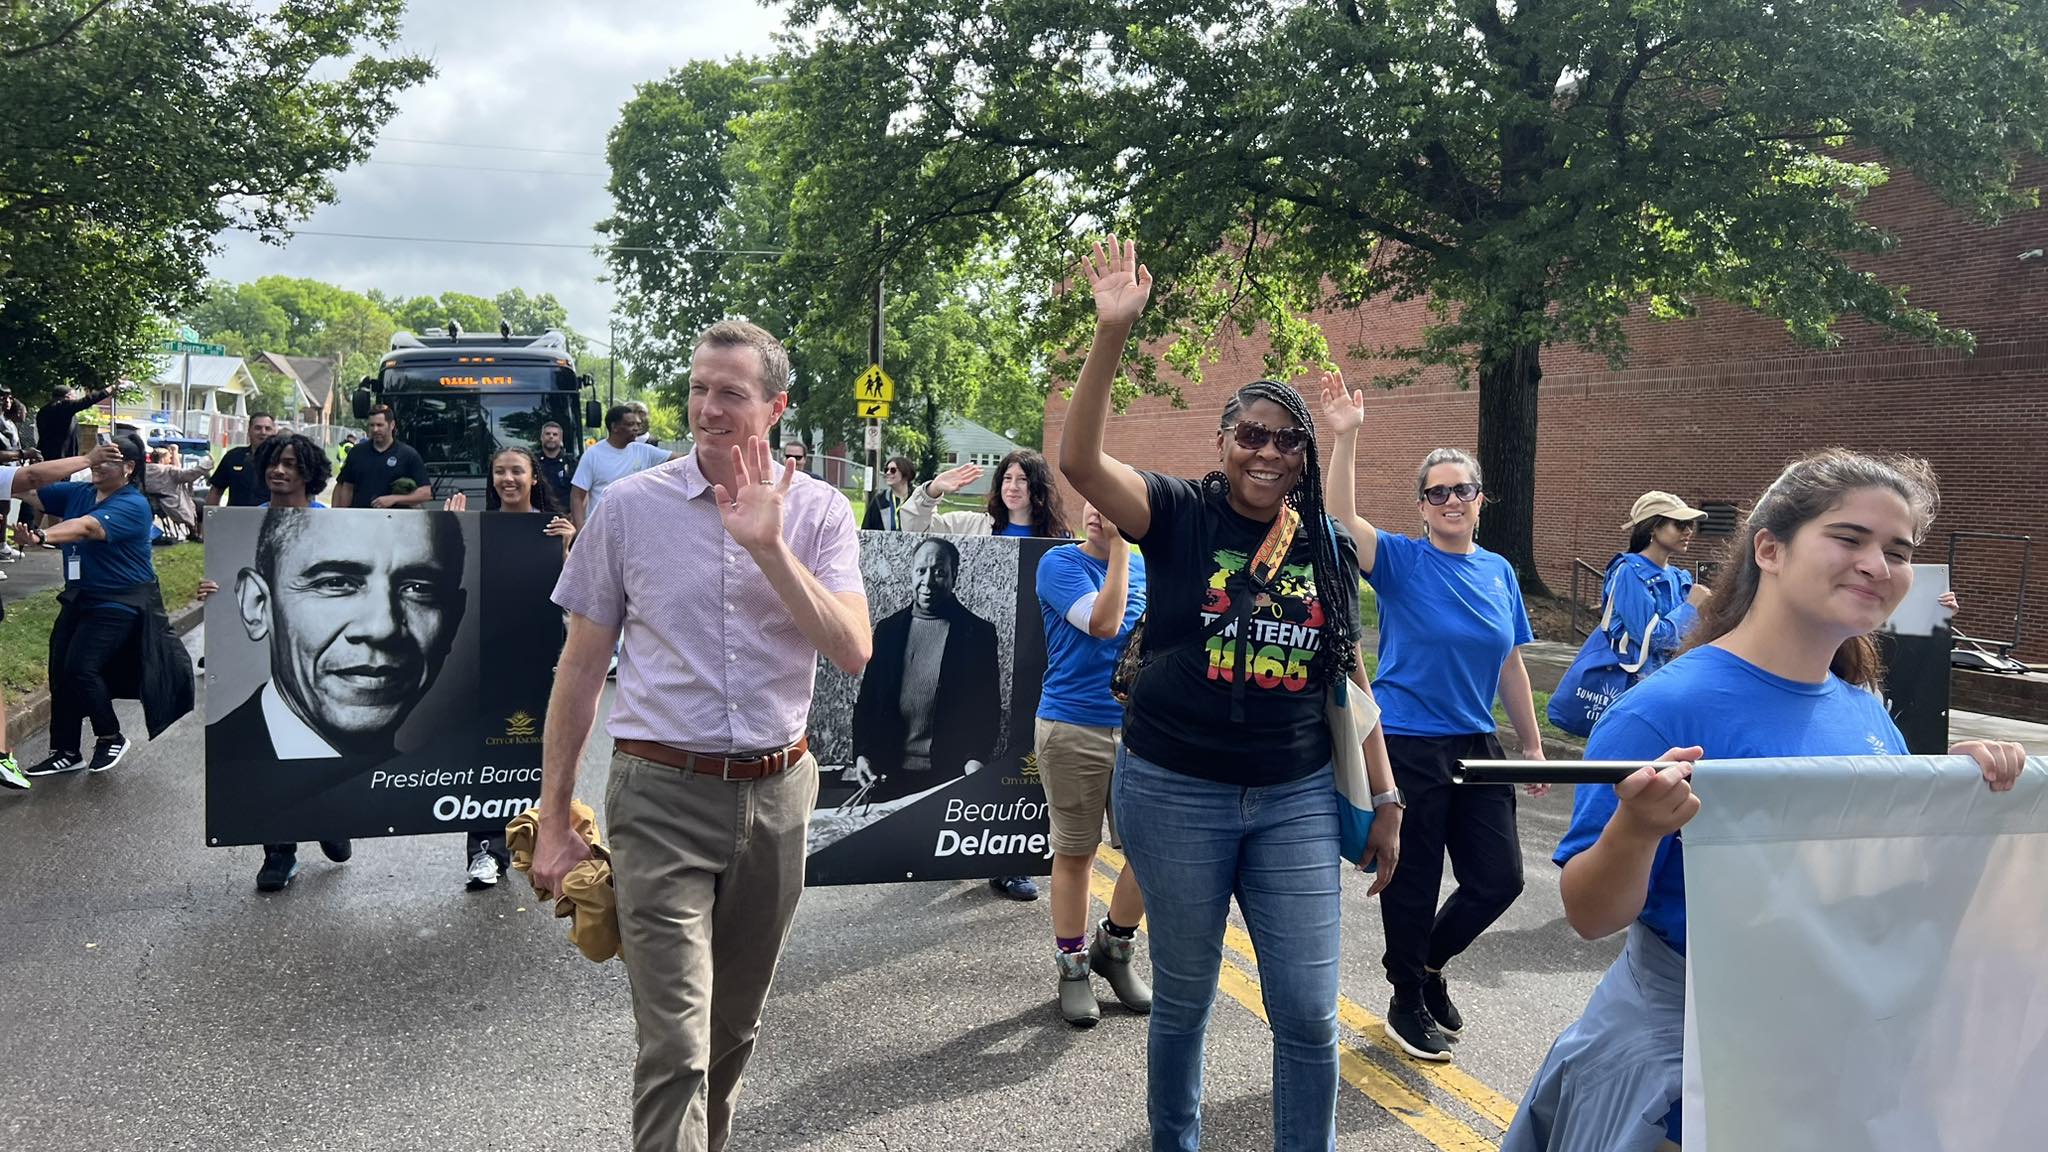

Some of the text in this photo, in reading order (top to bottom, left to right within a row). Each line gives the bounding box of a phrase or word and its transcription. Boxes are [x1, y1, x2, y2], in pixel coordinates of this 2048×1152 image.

[178, 342, 205, 353] Bourne
[1205, 635, 1315, 692] 1865
[1576, 687, 1609, 706] SUMMER
[1587, 710, 1600, 721] CIT
[371, 765, 543, 789] President Barac
[433, 794, 542, 822] Obam
[944, 797, 1049, 822] Beaufor
